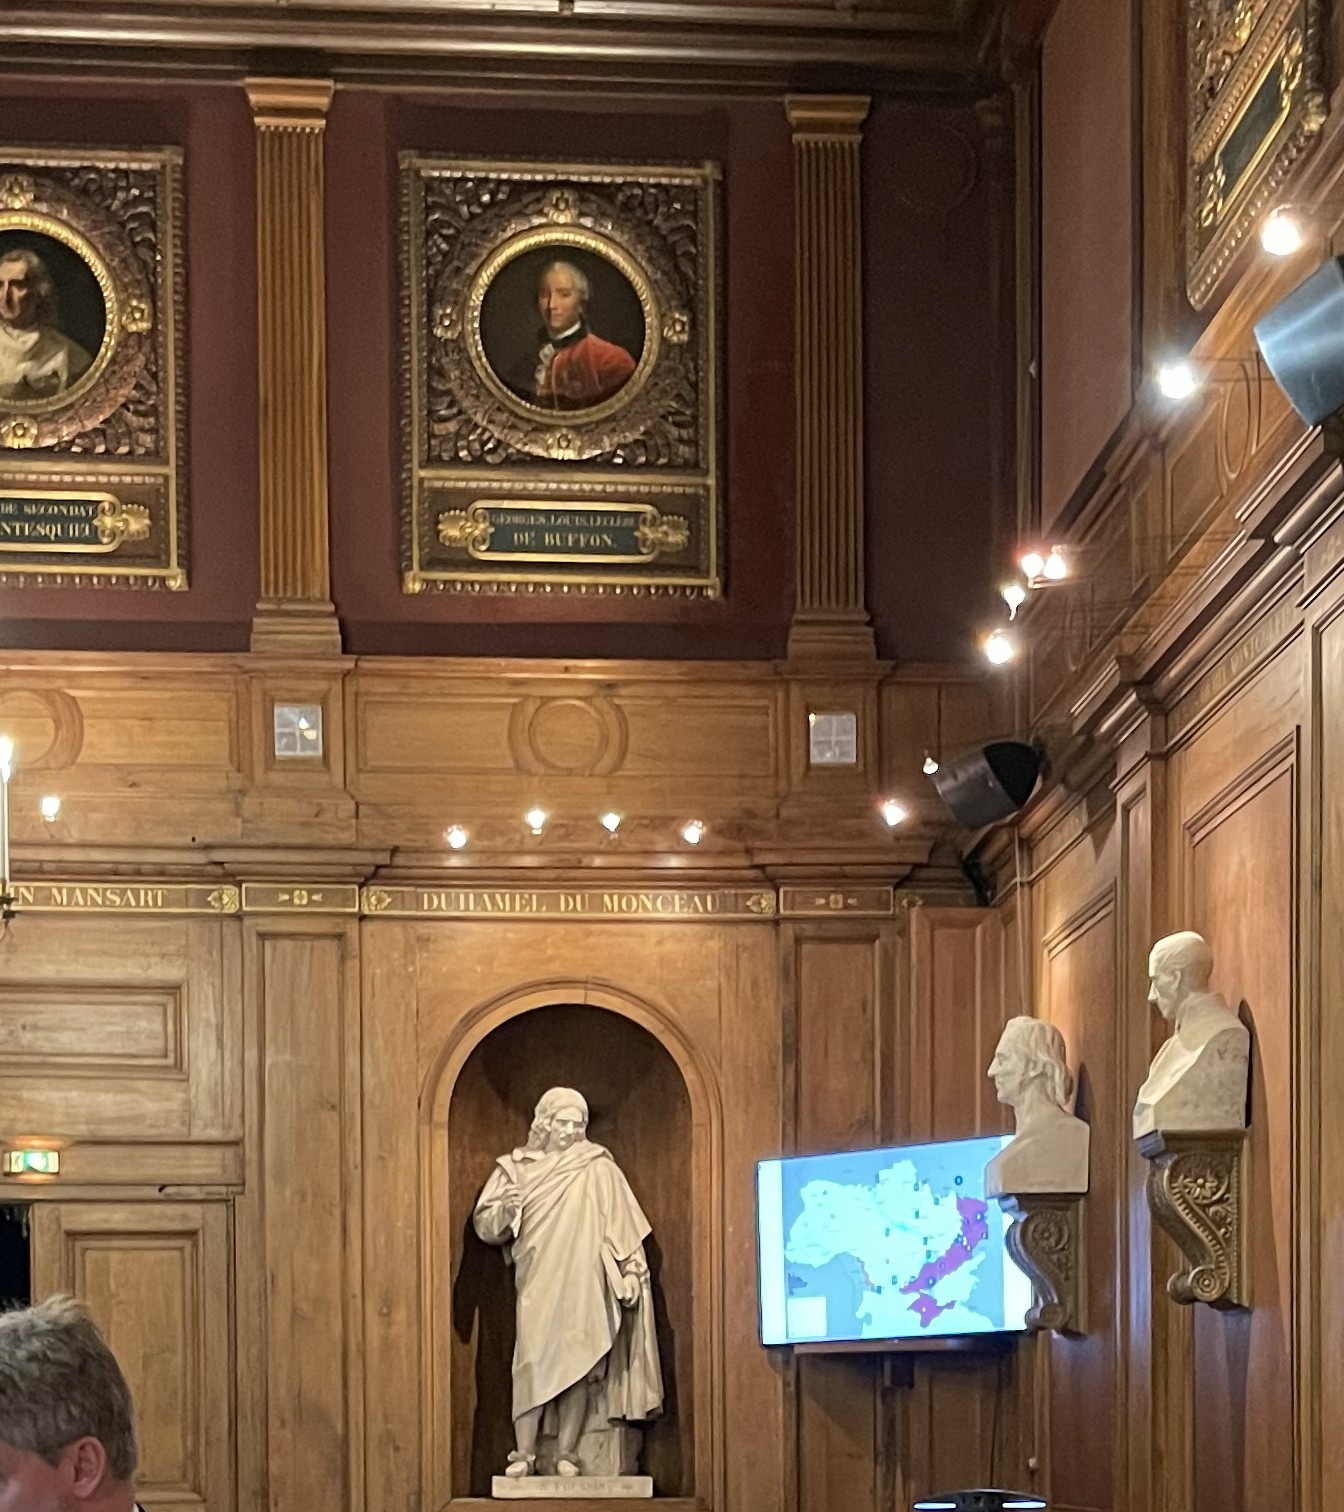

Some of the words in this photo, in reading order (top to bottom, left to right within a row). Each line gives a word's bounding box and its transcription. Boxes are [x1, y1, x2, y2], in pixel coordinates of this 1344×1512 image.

[51, 886, 168, 908] MANSART
[423, 893, 547, 912] DUHAMEL
[560, 893, 590, 912] DU
[602, 893, 721, 913] MONCEAU
